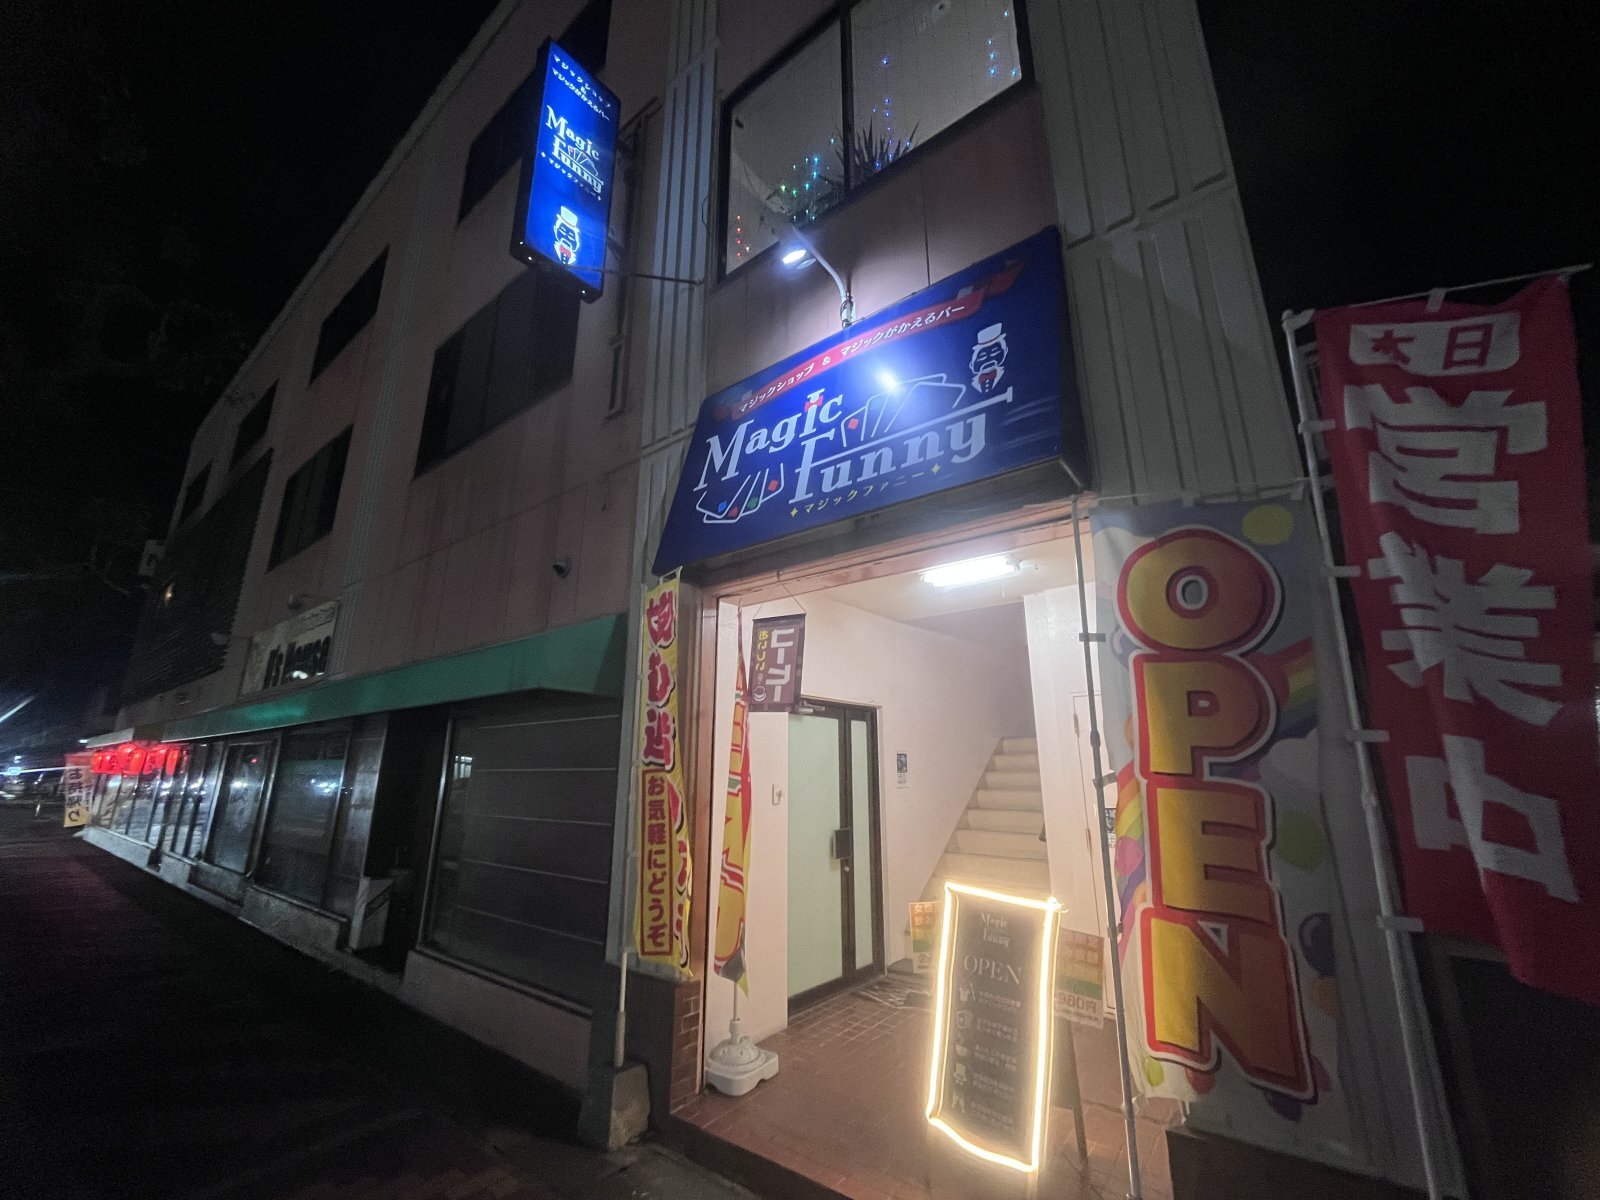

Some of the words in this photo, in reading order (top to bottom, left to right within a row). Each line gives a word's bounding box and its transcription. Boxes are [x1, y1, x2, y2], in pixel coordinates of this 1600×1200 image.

[545, 104, 600, 161] Magic
[552, 135, 604, 193] Funny
[739, 363, 816, 413] マジックショップ
[822, 355, 832, 366] &
[840, 304, 966, 356] マジックがかえるバー
[693, 388, 844, 492] Magic
[788, 386, 1013, 505] Funny
[804, 471, 926, 514] マジックファニー
[1343, 383, 1581, 904] 営業中
[647, 775, 668, 948] お気軽にどうぞ
[1114, 526, 1320, 1104] OPEN
[963, 955, 1022, 985] OPEN
